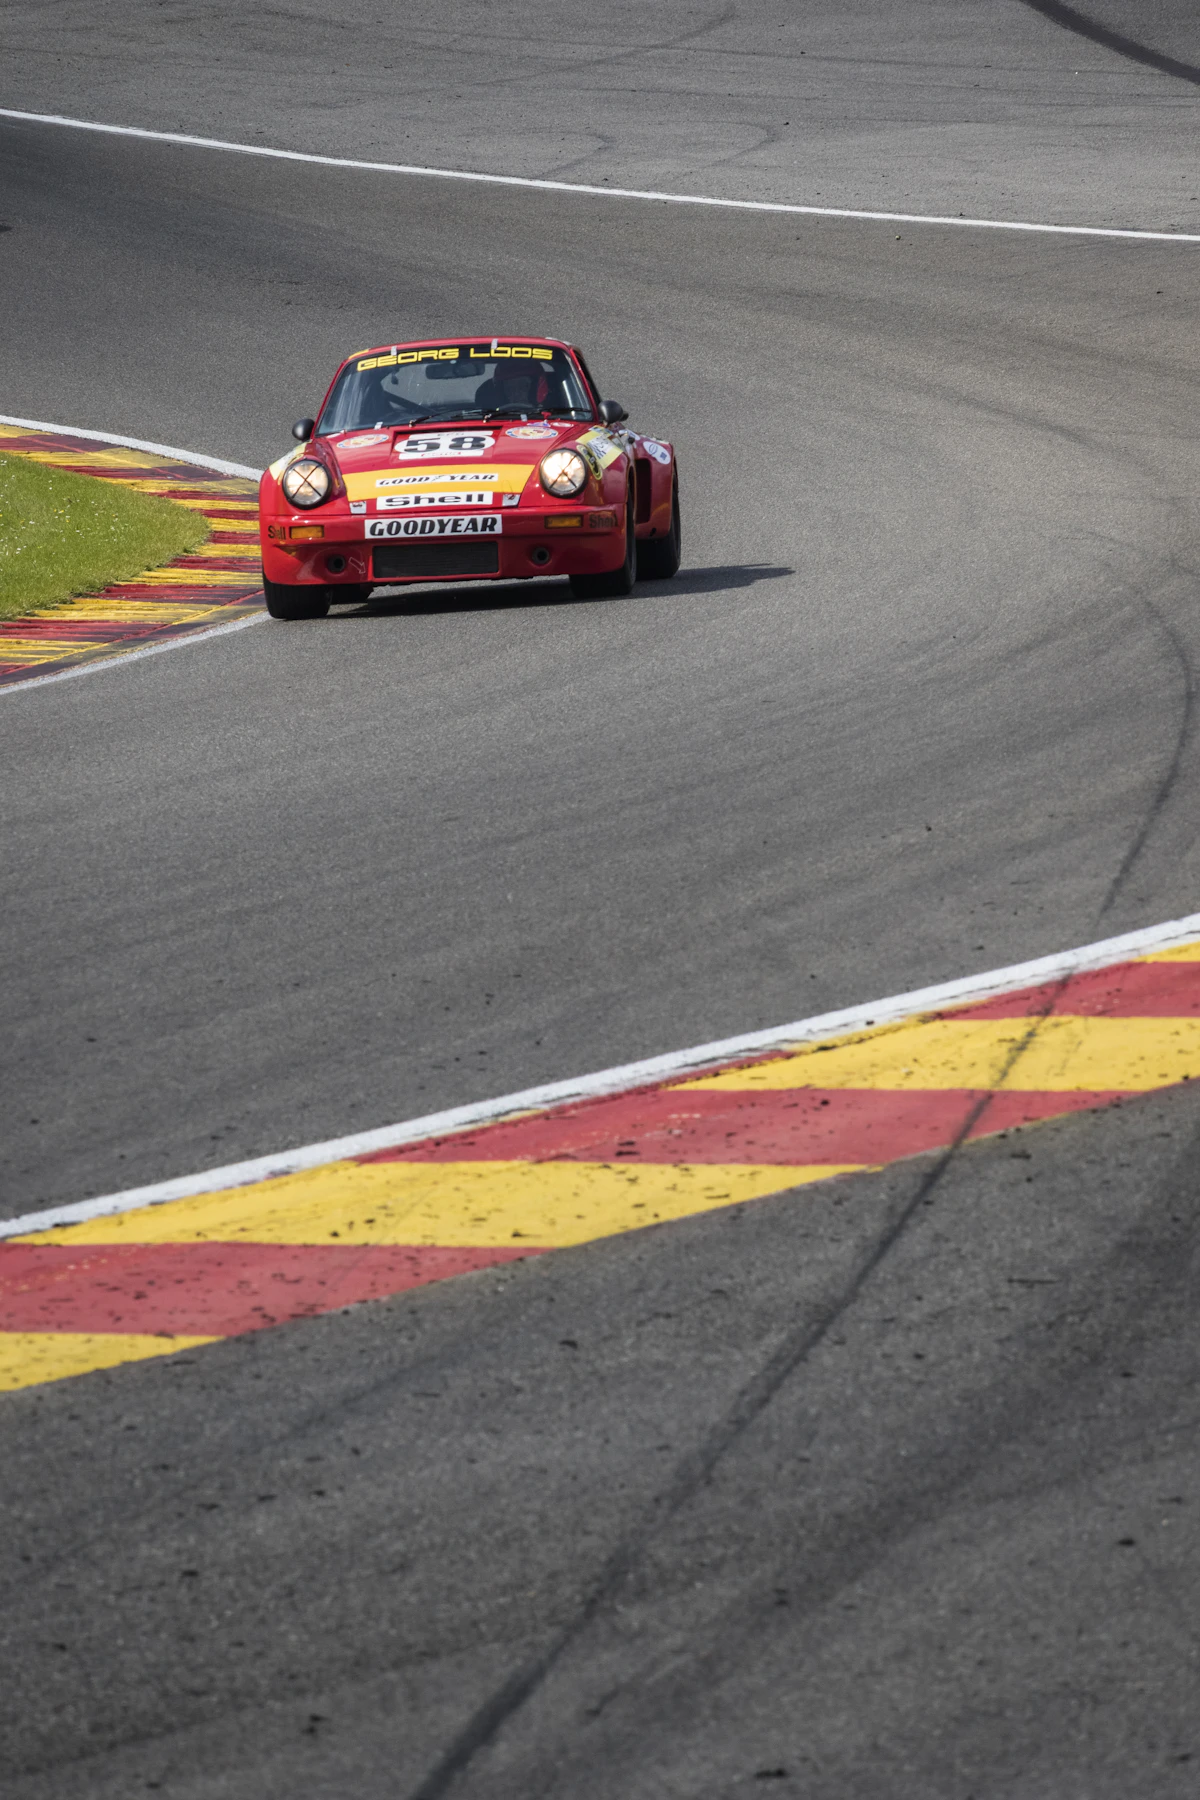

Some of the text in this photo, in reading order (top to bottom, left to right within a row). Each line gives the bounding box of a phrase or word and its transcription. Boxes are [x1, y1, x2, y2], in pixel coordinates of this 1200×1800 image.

[357, 346, 553, 371] GEORG LOOS
[404, 436, 486, 453] 58
[385, 493, 484, 507] Shell
[369, 516, 498, 537] GOODYEAR
